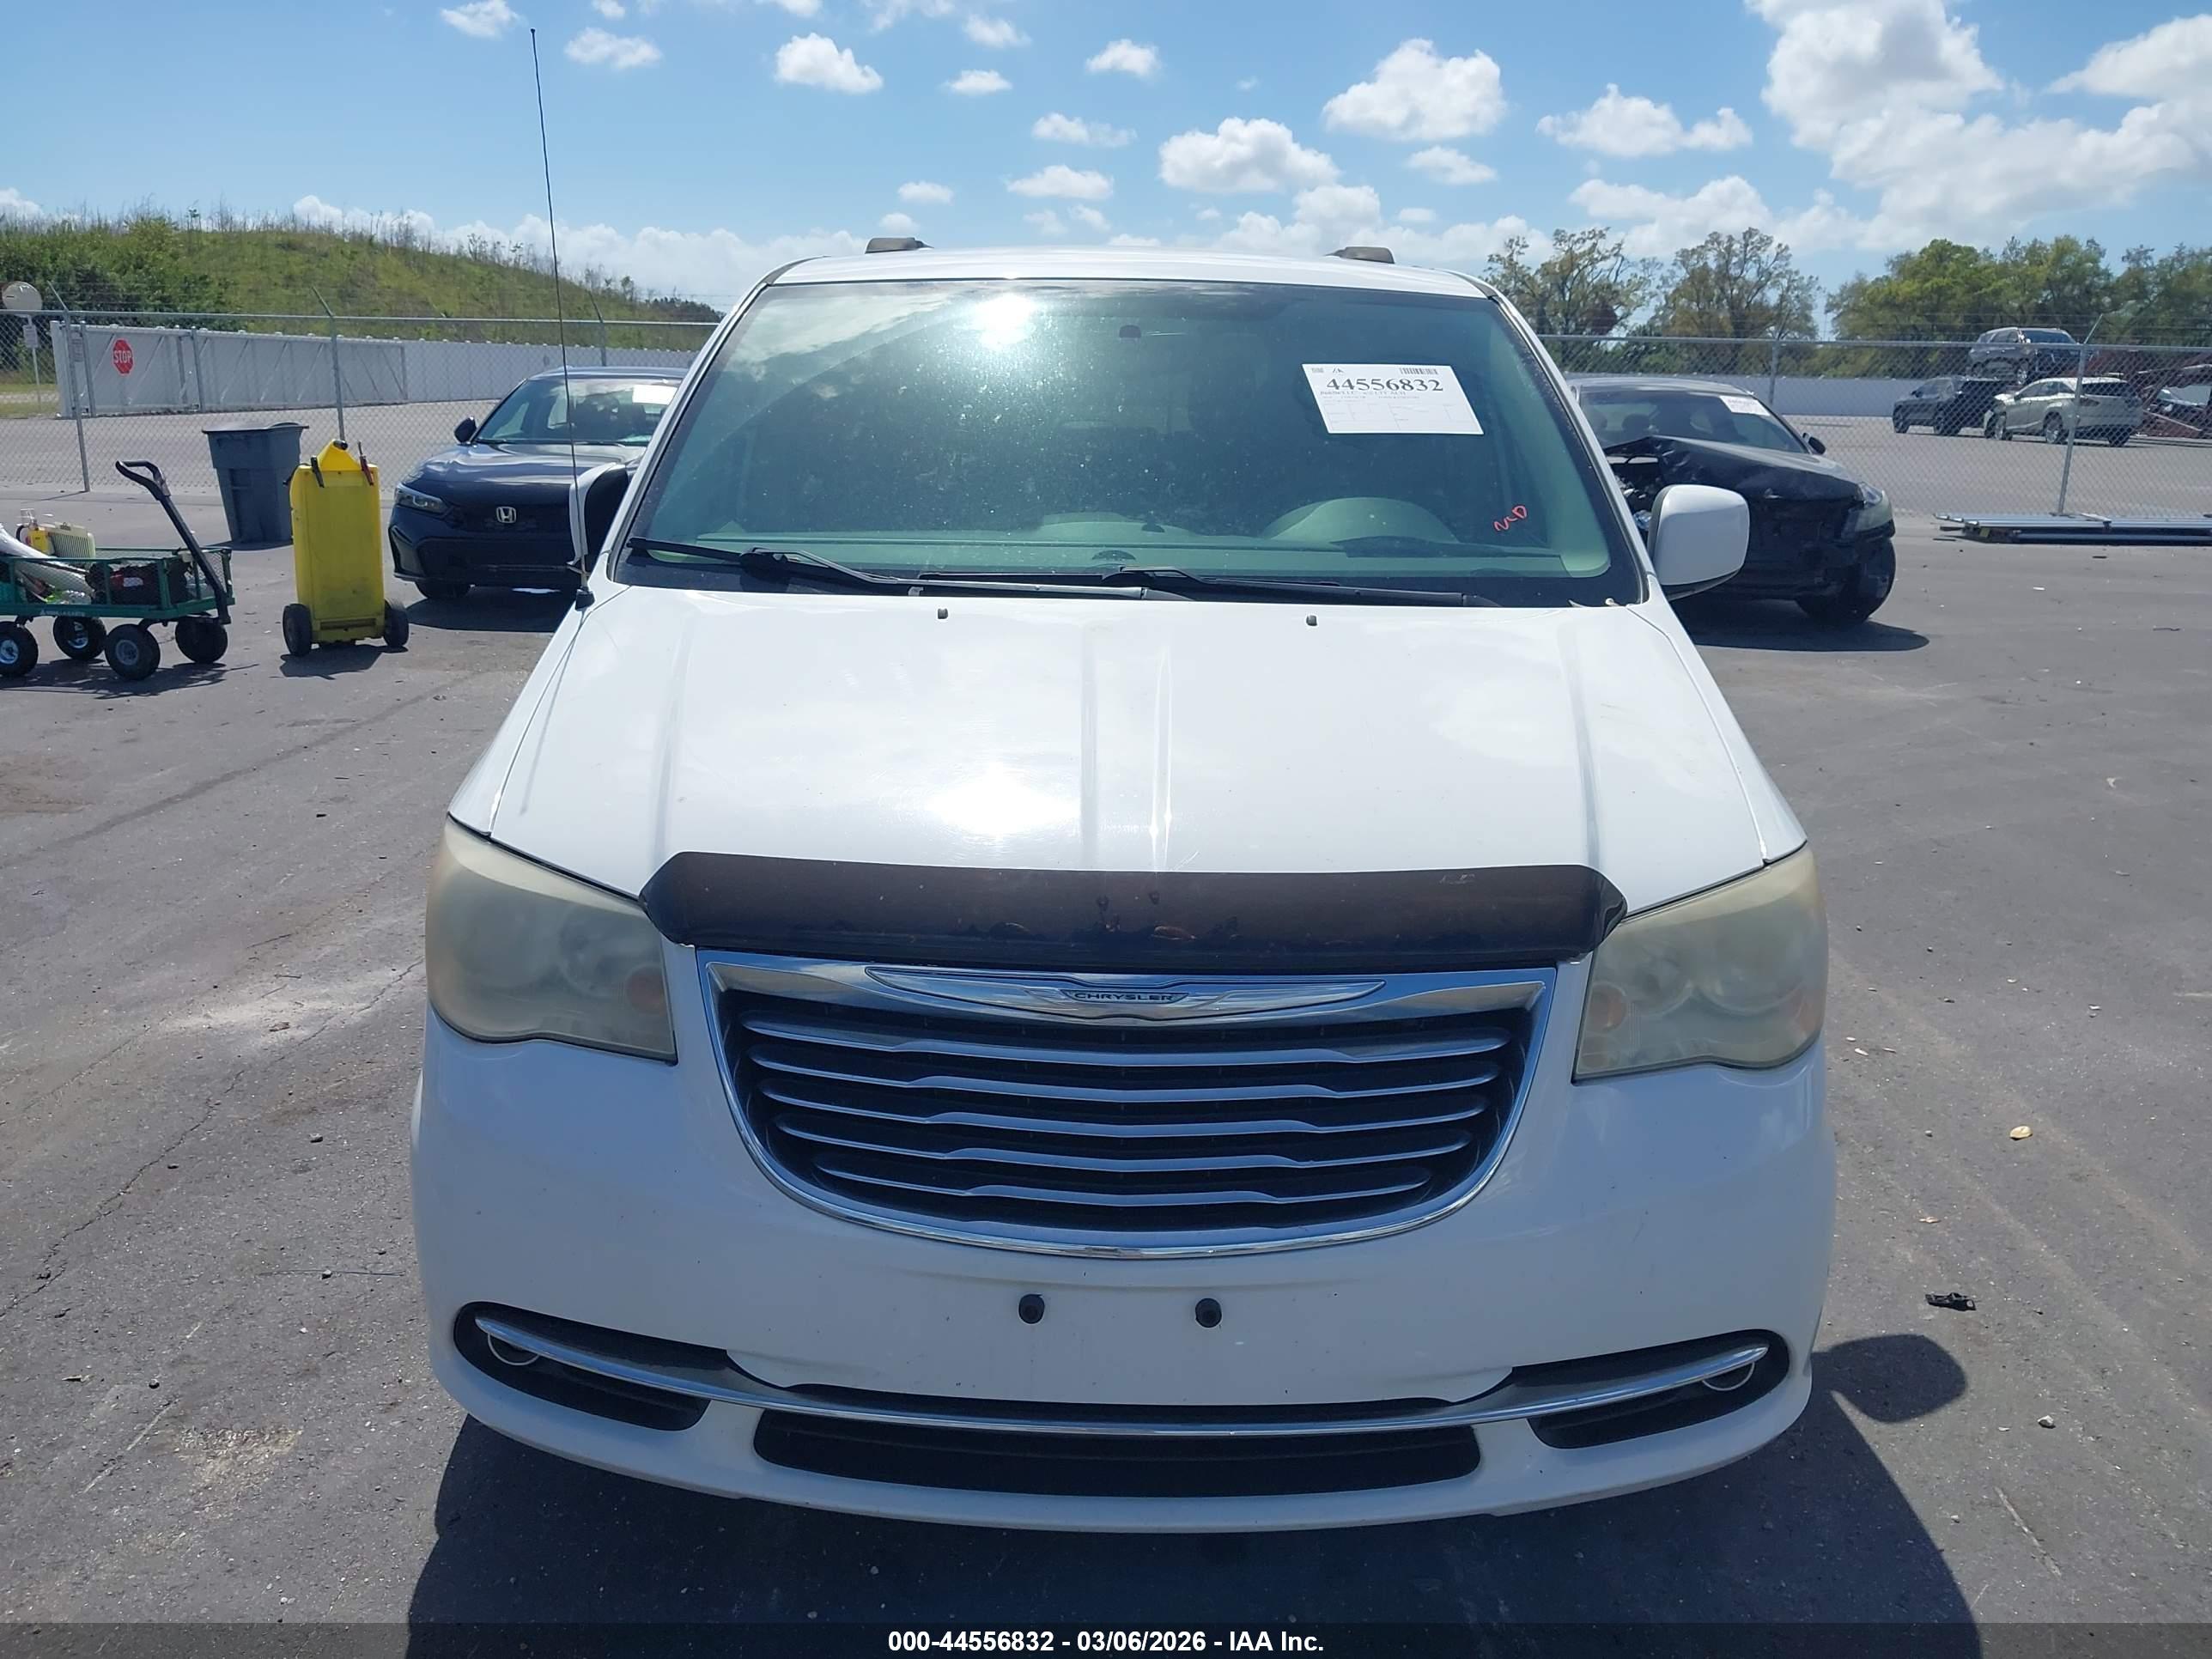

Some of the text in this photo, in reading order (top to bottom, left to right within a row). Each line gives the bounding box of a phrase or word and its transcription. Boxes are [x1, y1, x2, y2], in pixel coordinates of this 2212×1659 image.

[113, 349, 132, 363] STOP
[1326, 378, 1443, 392] 44556832
[1074, 992, 1172, 1001] CHRYSLER
